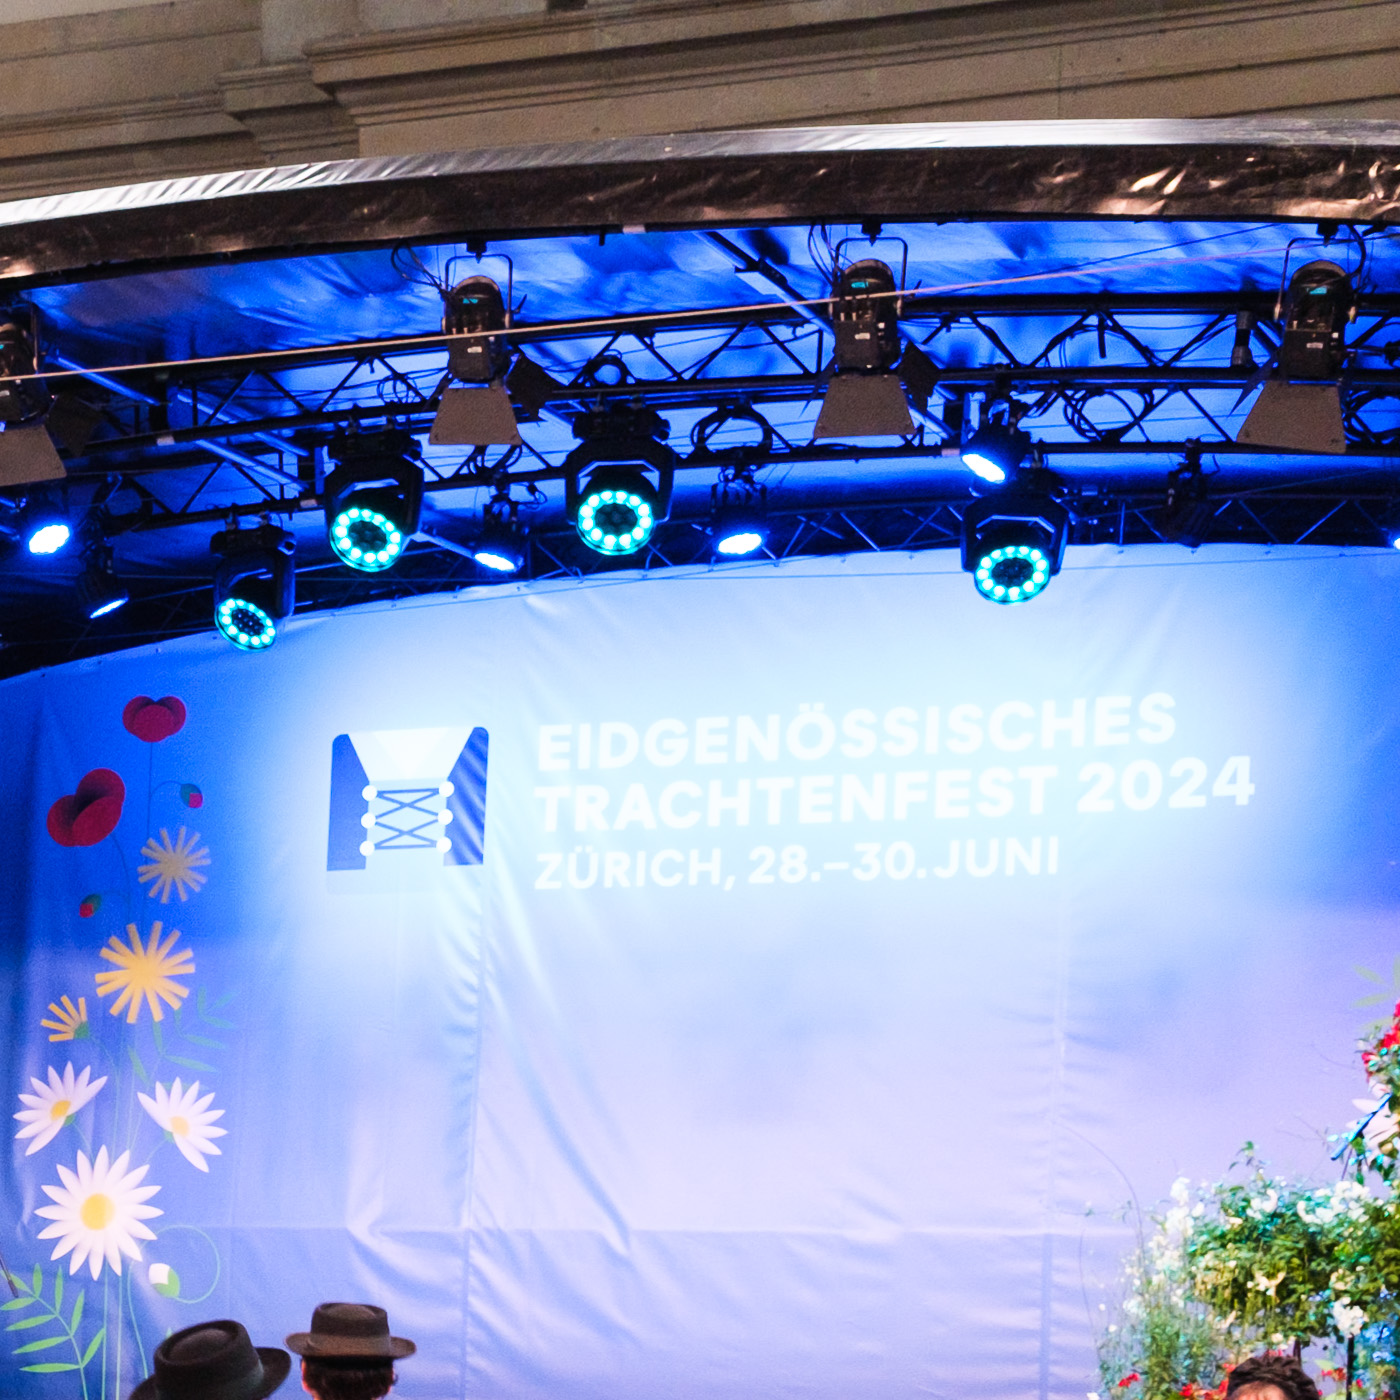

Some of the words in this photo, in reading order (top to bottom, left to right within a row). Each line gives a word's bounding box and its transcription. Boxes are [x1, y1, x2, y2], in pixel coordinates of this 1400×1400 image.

[537, 692, 1177, 772] EIDGENÖSSISCHES
[534, 765, 1059, 832] TRACHTENFEST
[1076, 755, 1257, 814] 2024
[534, 845, 736, 891] ZÜRICH,
